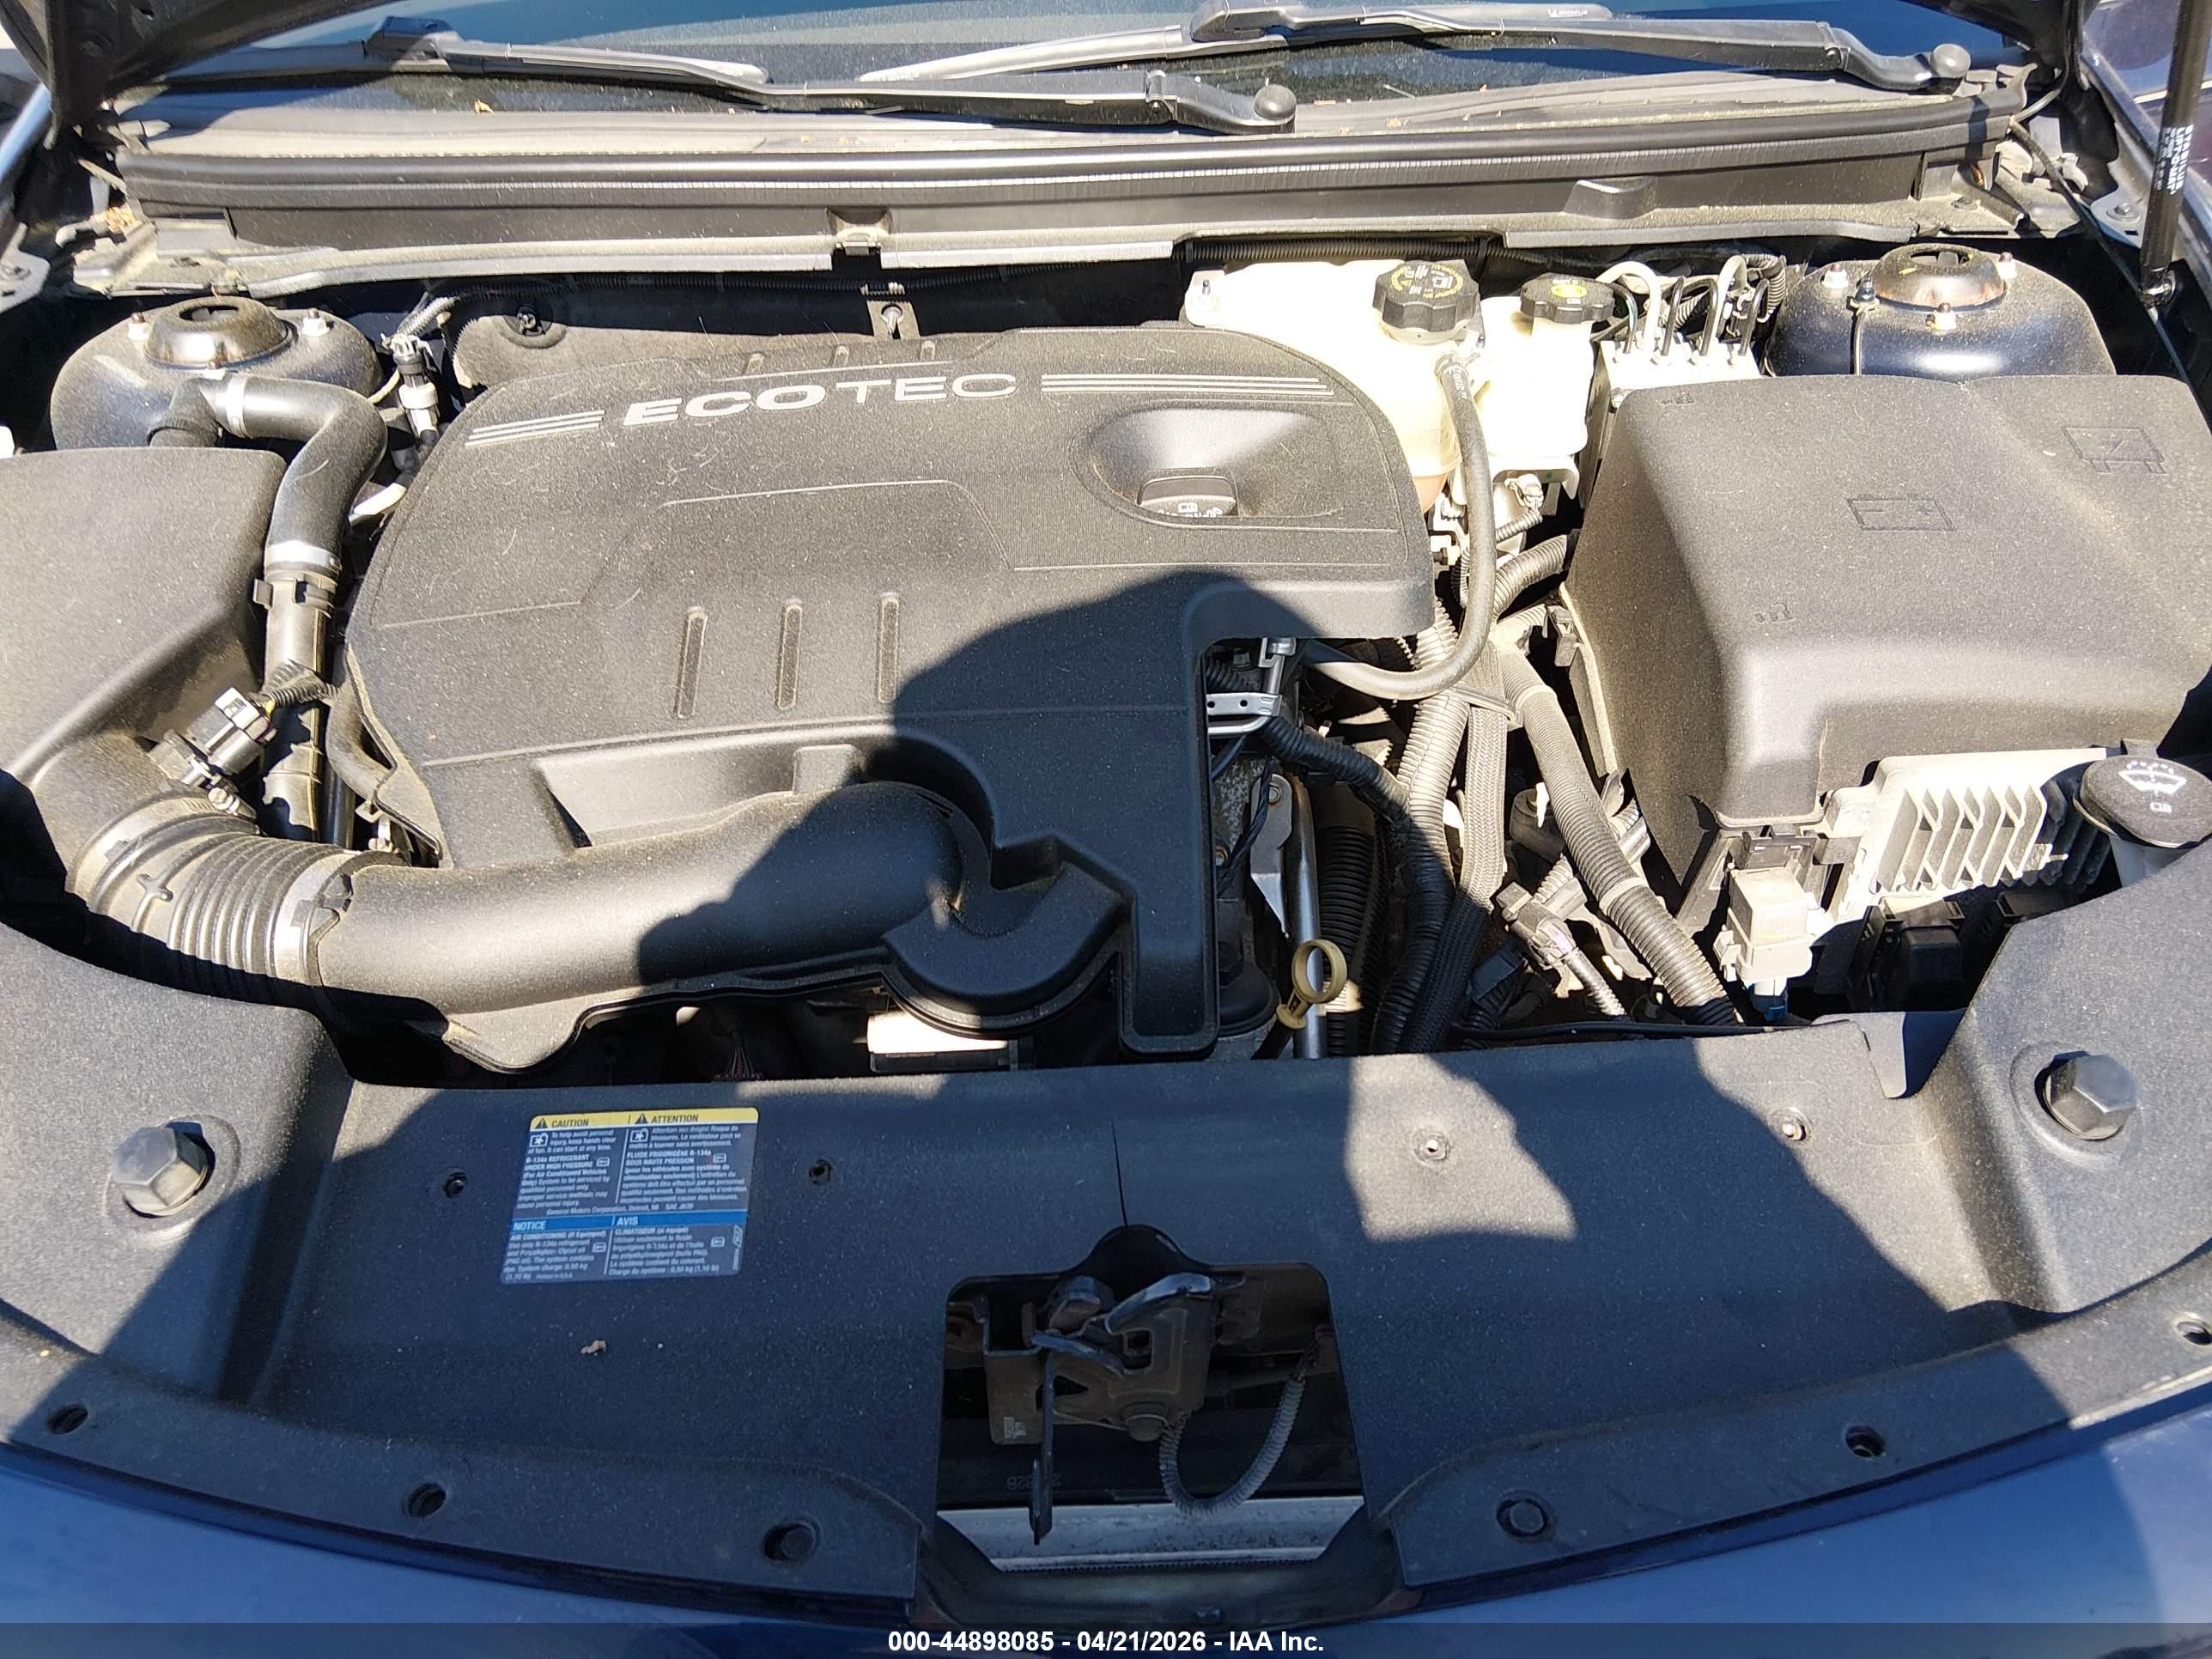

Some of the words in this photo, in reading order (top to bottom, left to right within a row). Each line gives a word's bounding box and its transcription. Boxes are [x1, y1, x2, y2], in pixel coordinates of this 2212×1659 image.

[623, 373, 1017, 427] ECOTEC
[550, 1119, 589, 1127] CAUTION
[651, 1114, 698, 1123] ATTENTION
[617, 1216, 639, 1225] AVIS
[513, 1220, 546, 1231] NOTICE
